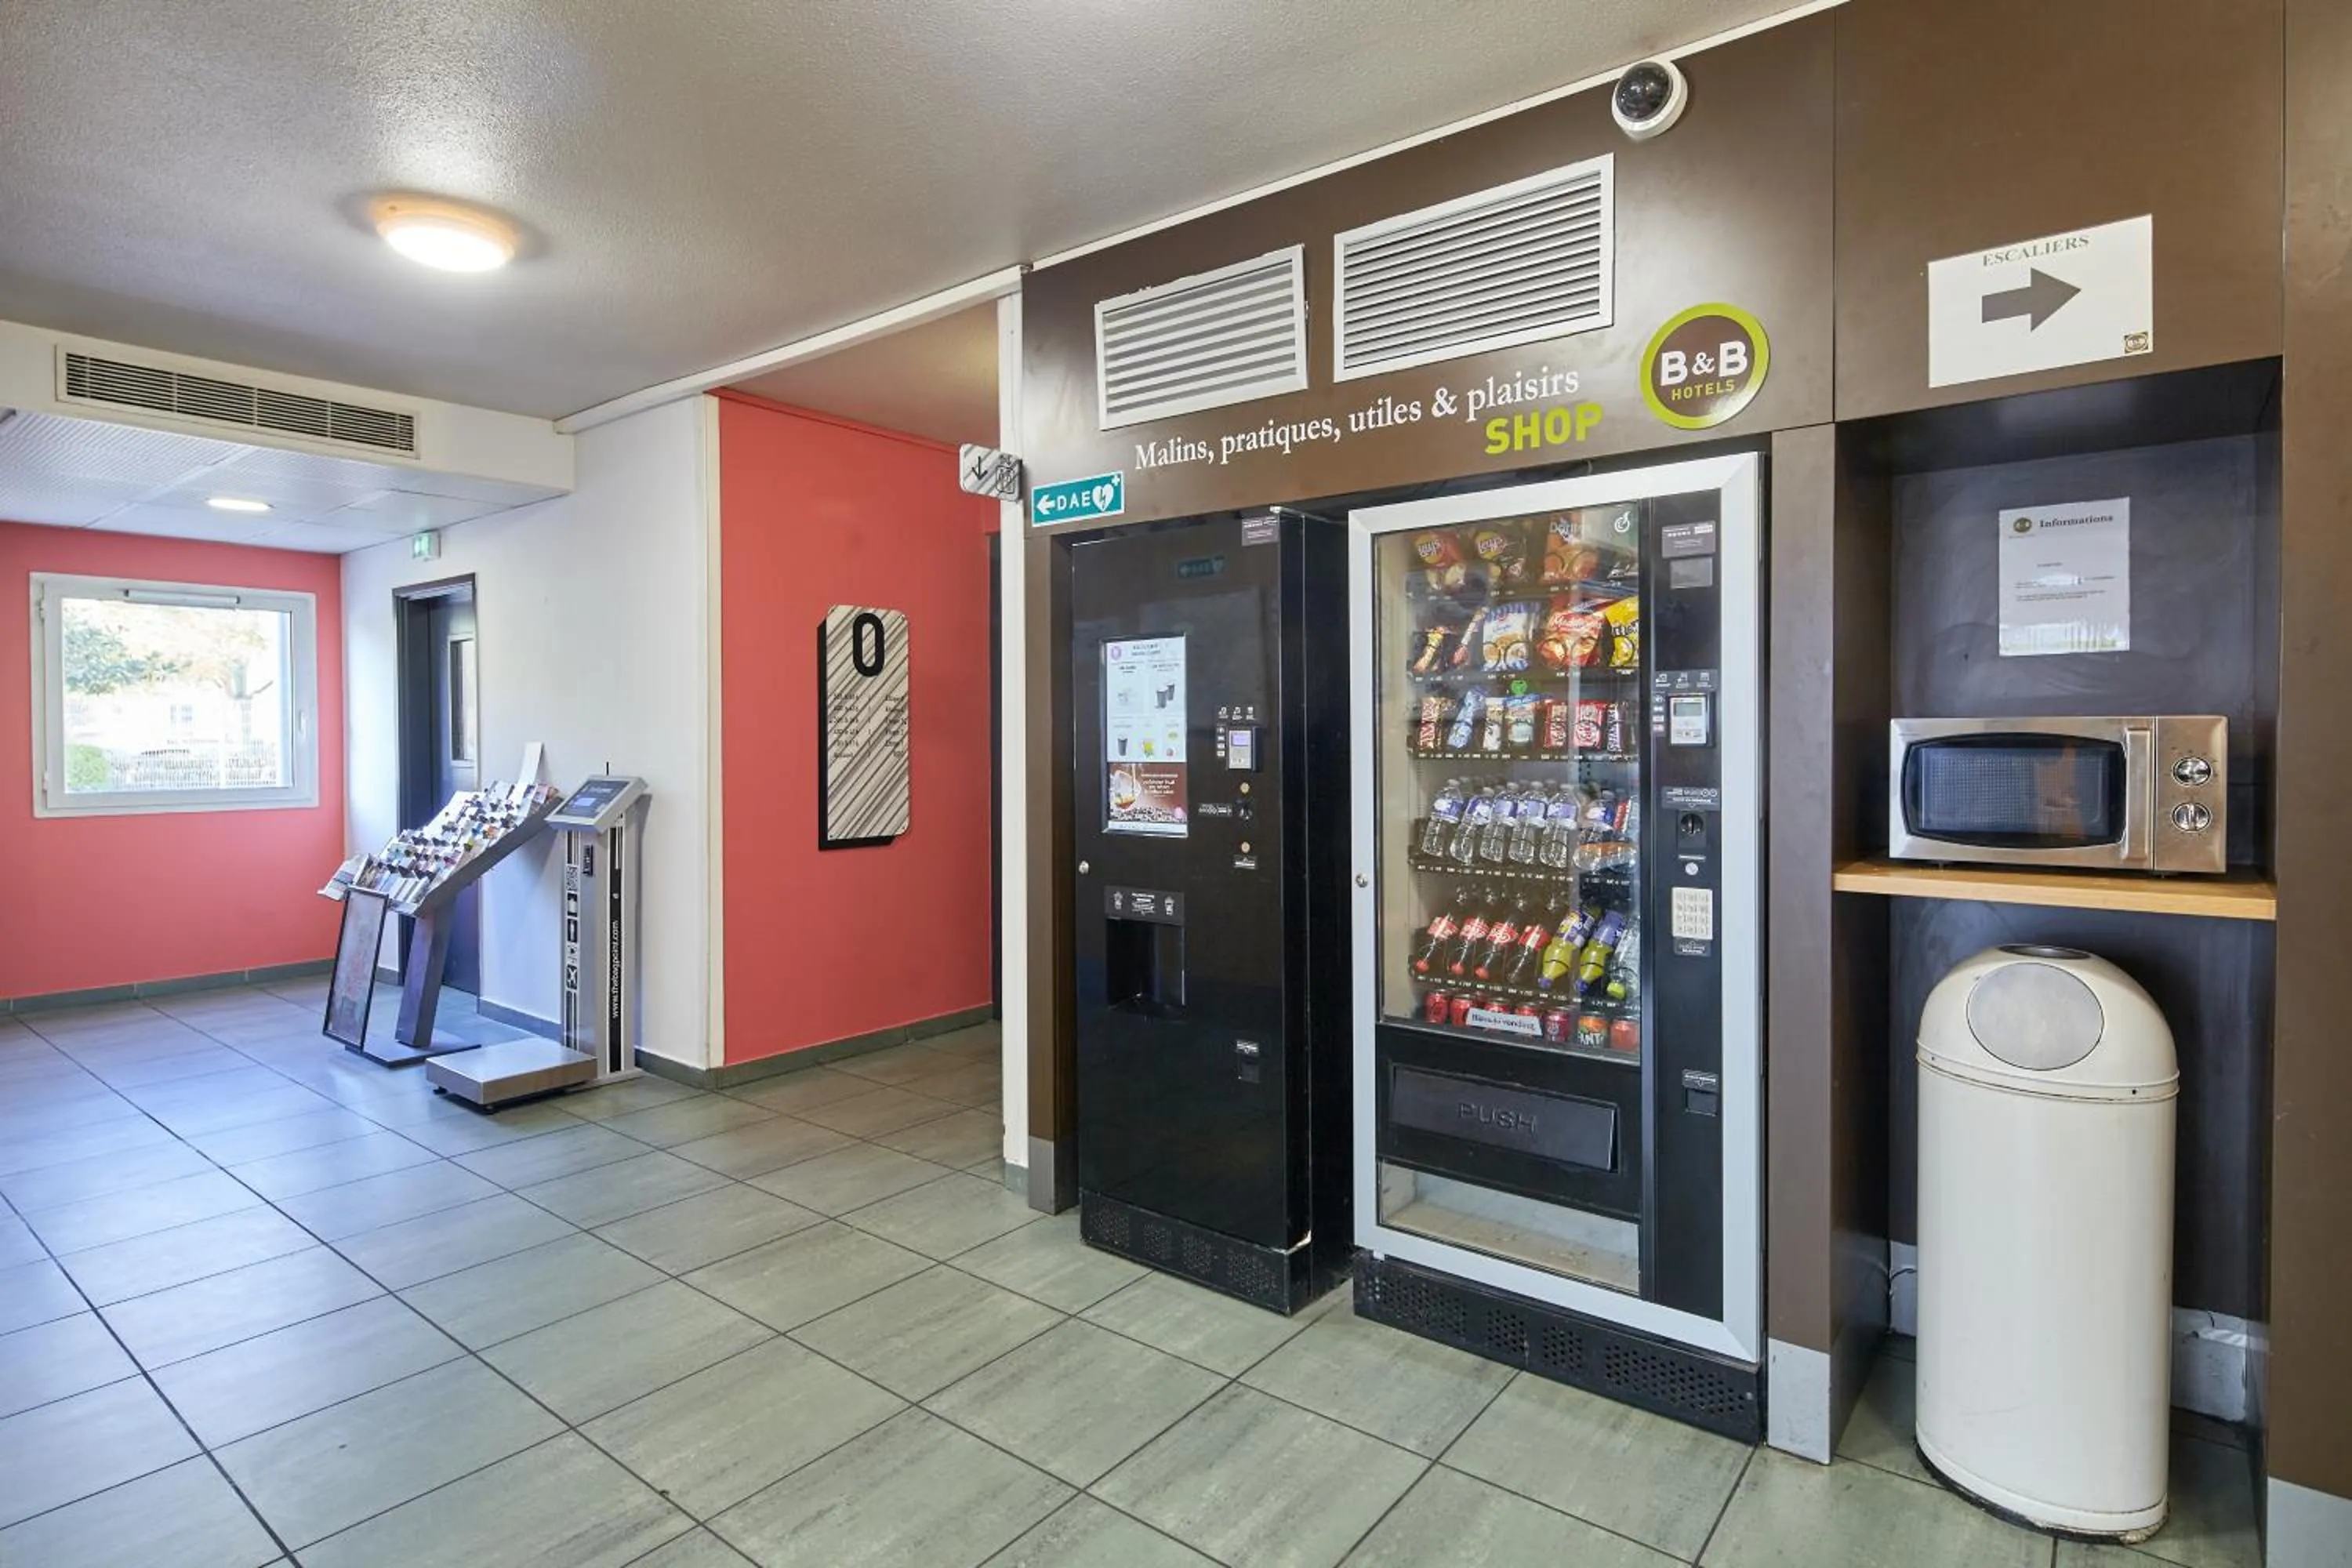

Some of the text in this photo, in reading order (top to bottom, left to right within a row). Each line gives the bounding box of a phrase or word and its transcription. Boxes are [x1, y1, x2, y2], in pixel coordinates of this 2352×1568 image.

[1982, 236, 2090, 267] ESCALIERS
[1671, 379, 1736, 401] HOTELS
[1134, 365, 1580, 470] Malins, pratiques, utiles & plaisirs
[1484, 402, 1604, 455] SHOP
[1057, 491, 1091, 510] DAE
[2039, 514, 2114, 528] Informations
[852, 612, 885, 677] 0
[1459, 1102, 1537, 1133] PUSH
